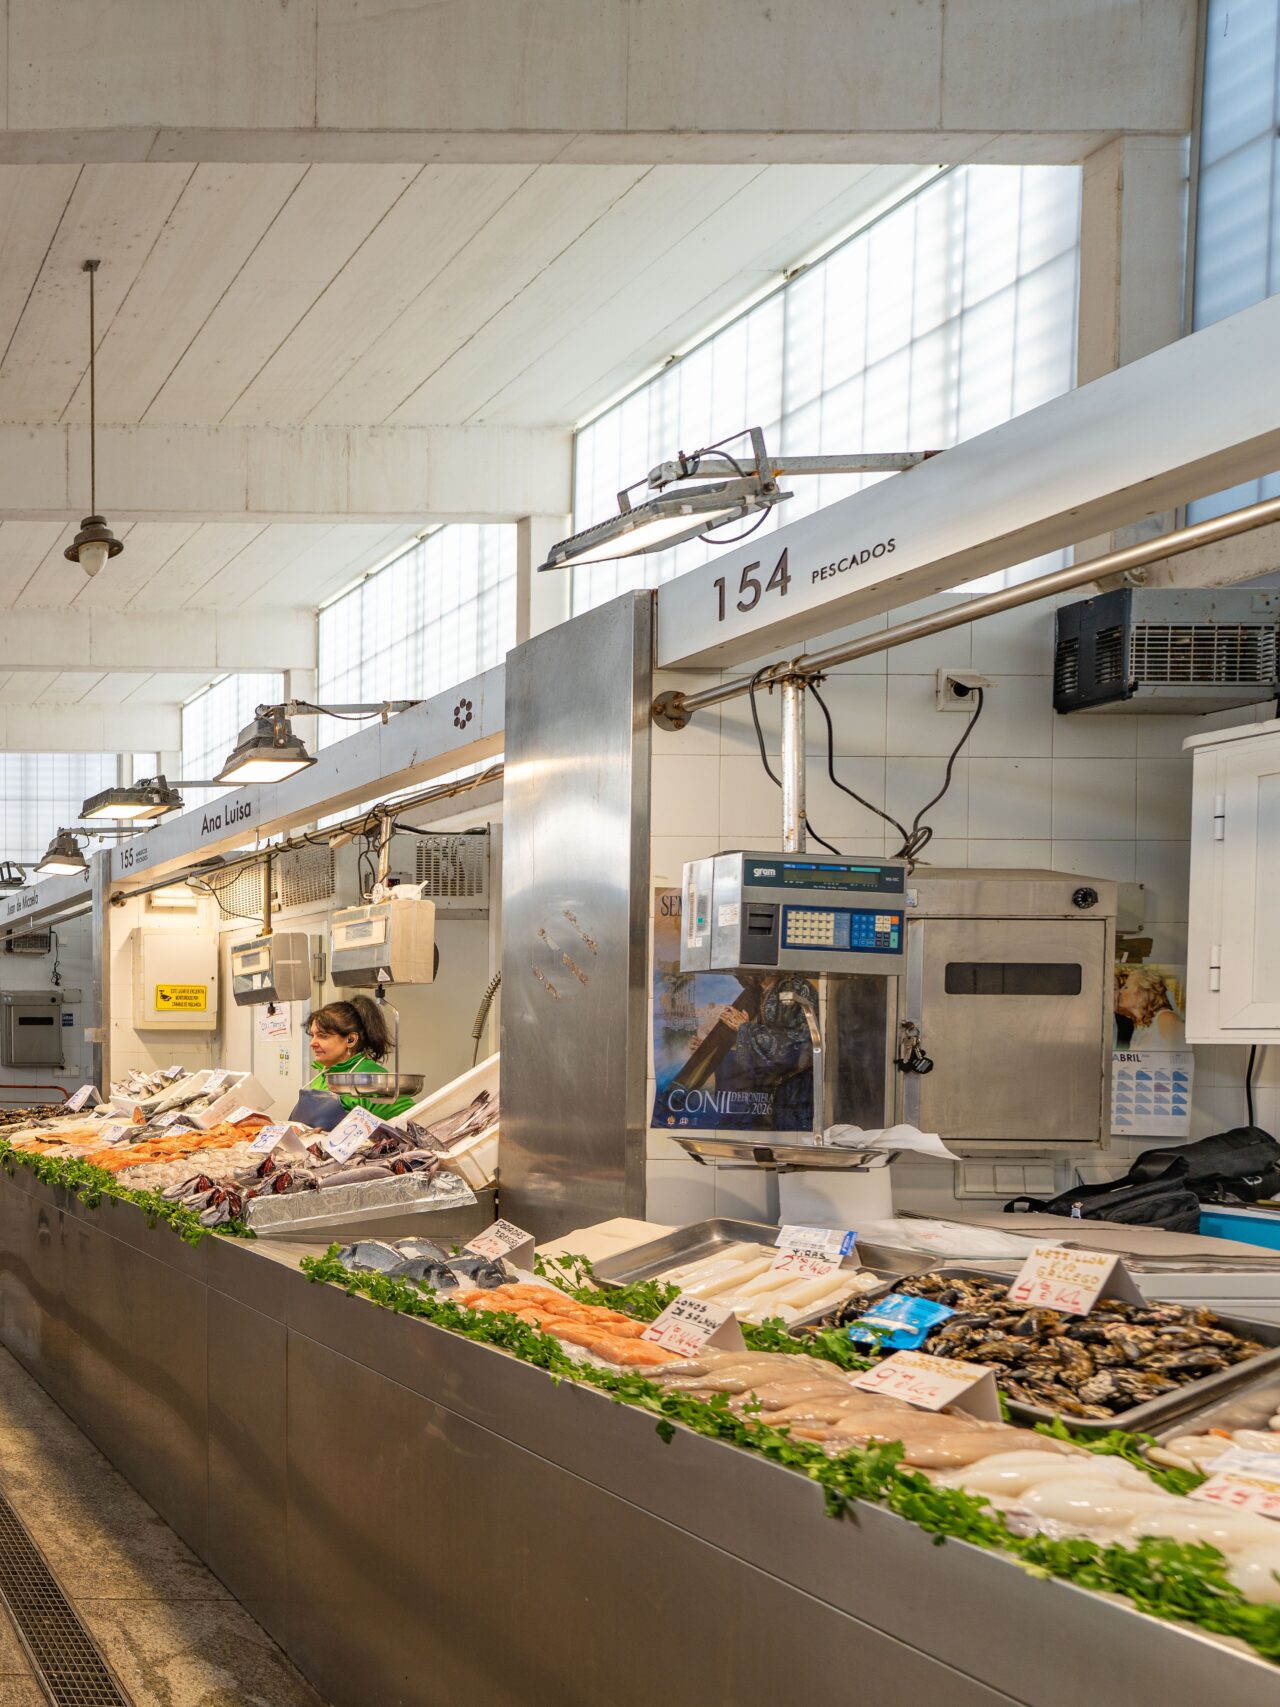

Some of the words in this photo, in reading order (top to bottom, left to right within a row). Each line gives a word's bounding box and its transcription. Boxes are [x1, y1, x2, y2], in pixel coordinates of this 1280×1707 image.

[713, 547, 791, 621] 154
[811, 538, 896, 584] PESCADOS
[201, 813, 221, 836] Ana
[224, 800, 251, 826] Luisa
[120, 847, 134, 870] 155
[753, 868, 776, 877] gram
[1112, 1053, 1142, 1063] ABRIL
[668, 1089, 750, 1114] CONIL
[751, 1102, 773, 1115] 2026
[1036, 1265, 1100, 1285] GALLEGO
